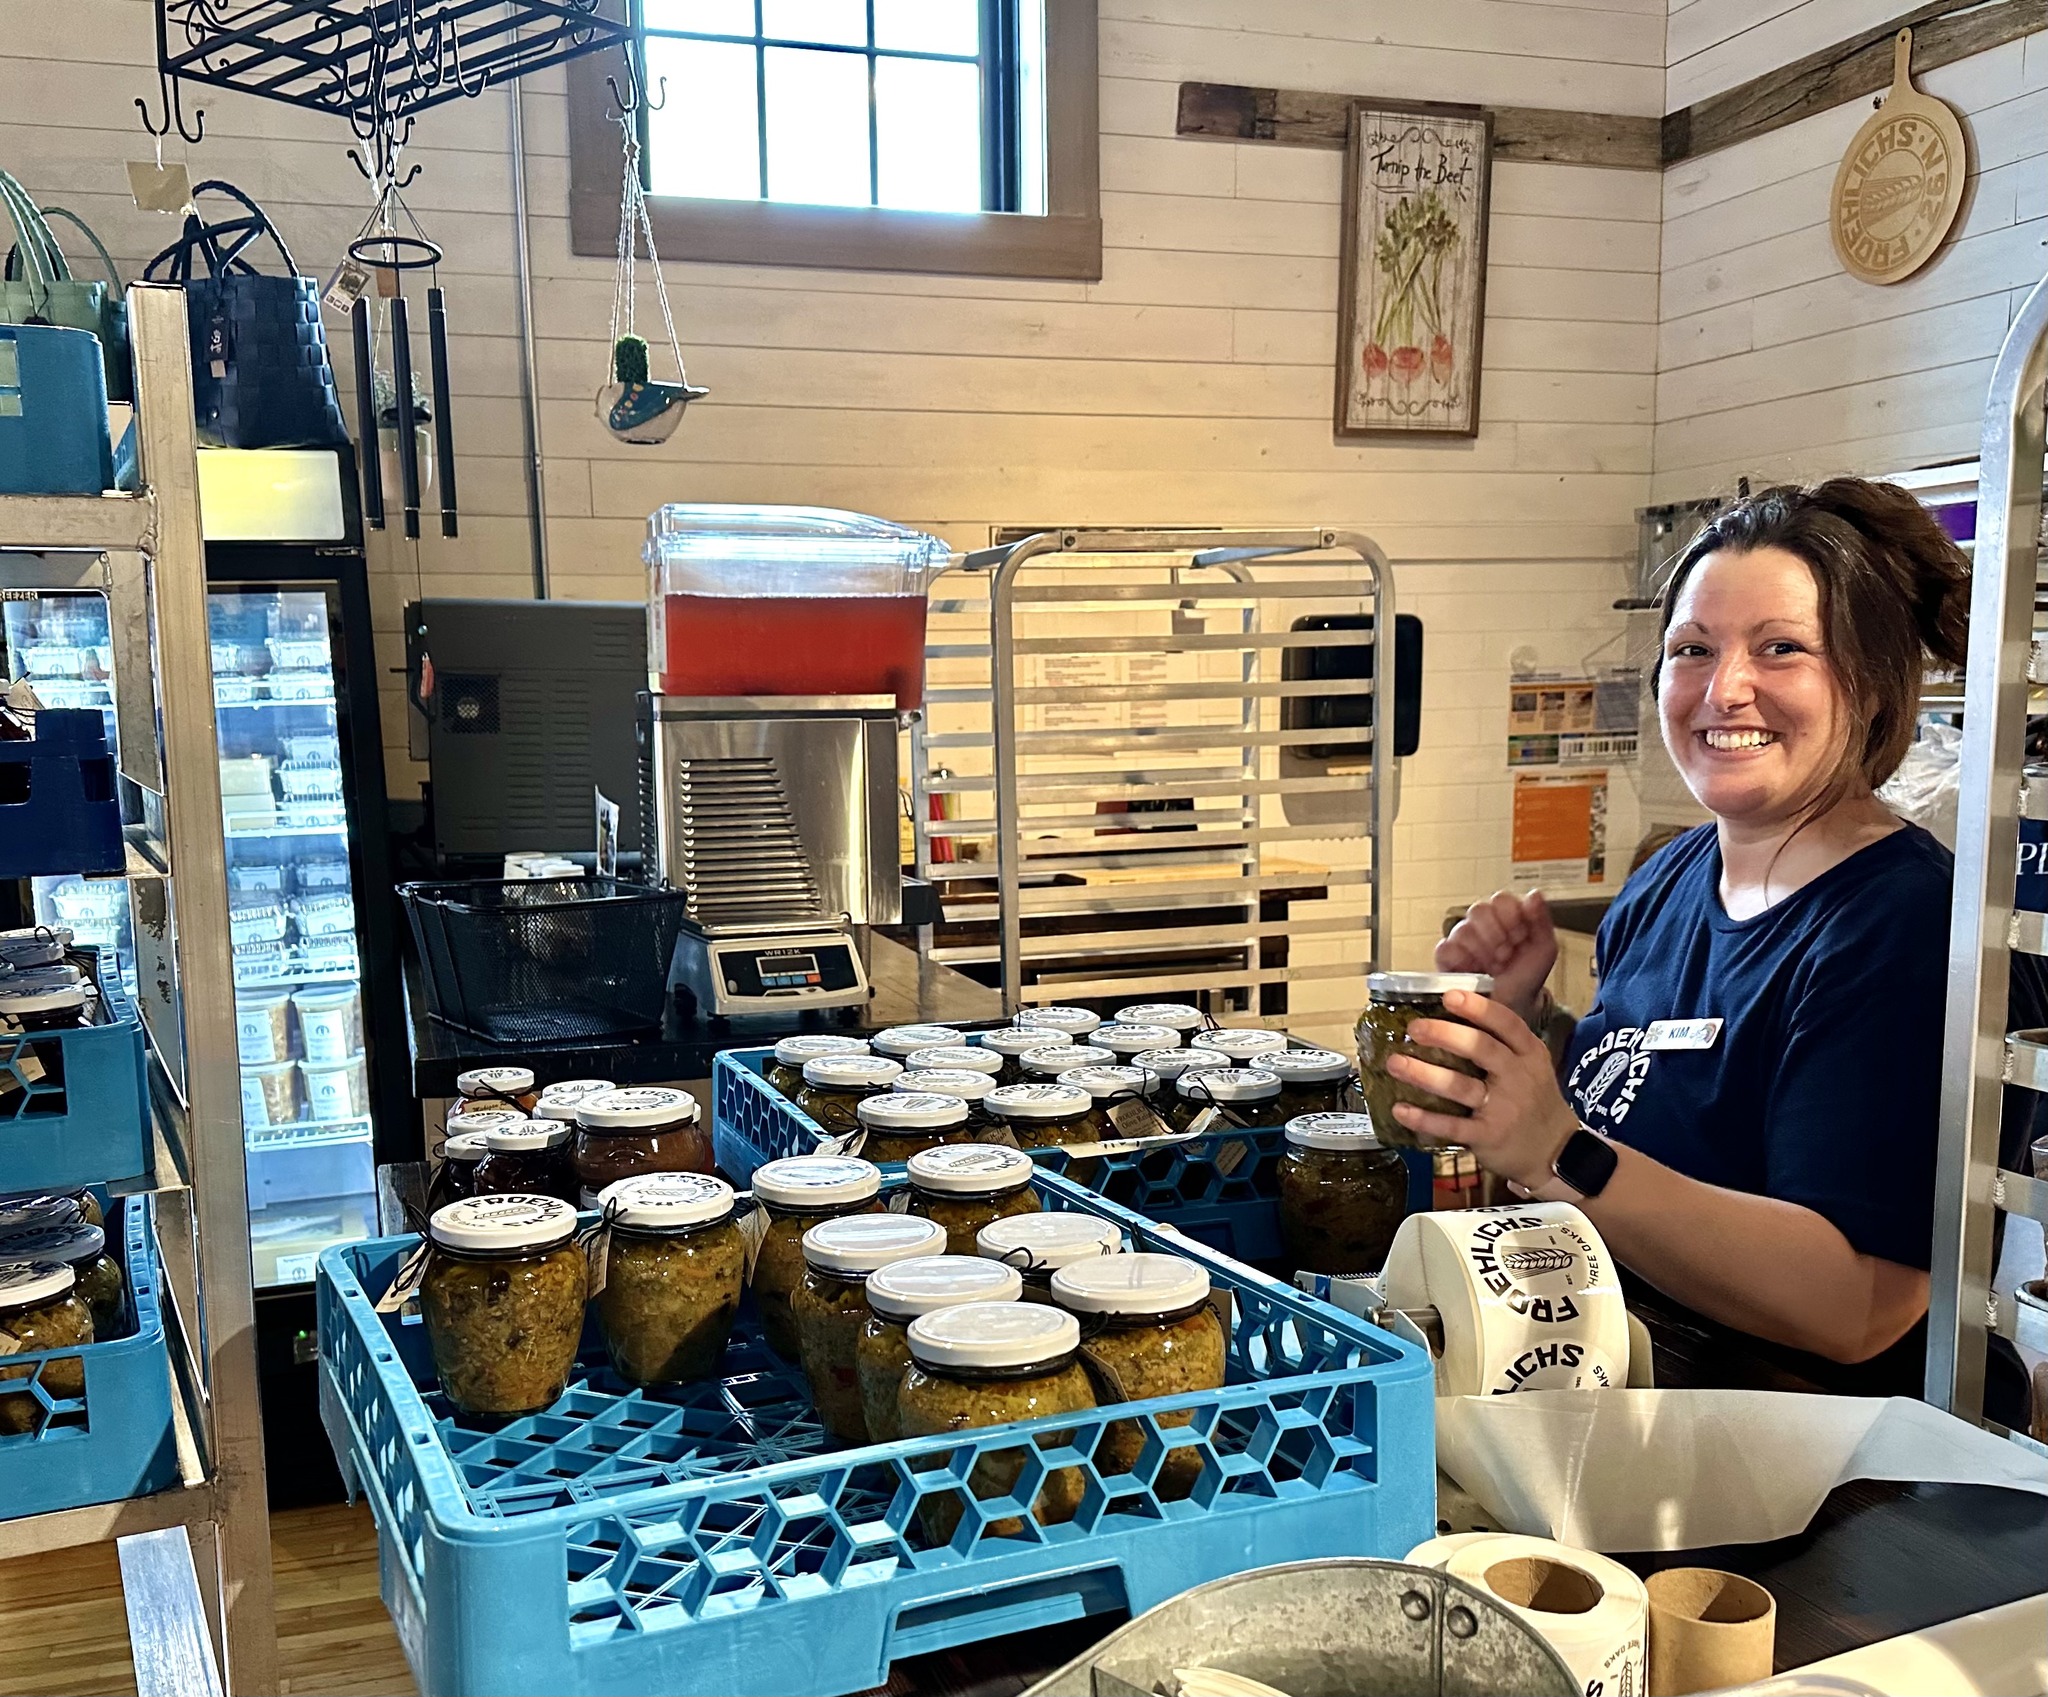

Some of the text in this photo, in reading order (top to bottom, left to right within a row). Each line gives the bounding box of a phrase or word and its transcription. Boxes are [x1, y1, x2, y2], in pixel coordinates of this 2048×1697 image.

[1414, 155, 1432, 181] the
[1433, 154, 1473, 185] Beet
[1841, 121, 1917, 268] FROEHLICHS
[764, 948, 801, 957] WR12K
[1667, 1025, 1691, 1039] KIM
[463, 1196, 564, 1227] FROEHLICHS
[1560, 1227, 1592, 1252] OAKS
[1470, 1217, 1580, 1323] FROEHLICHS
[1593, 1365, 1610, 1388] AKS
